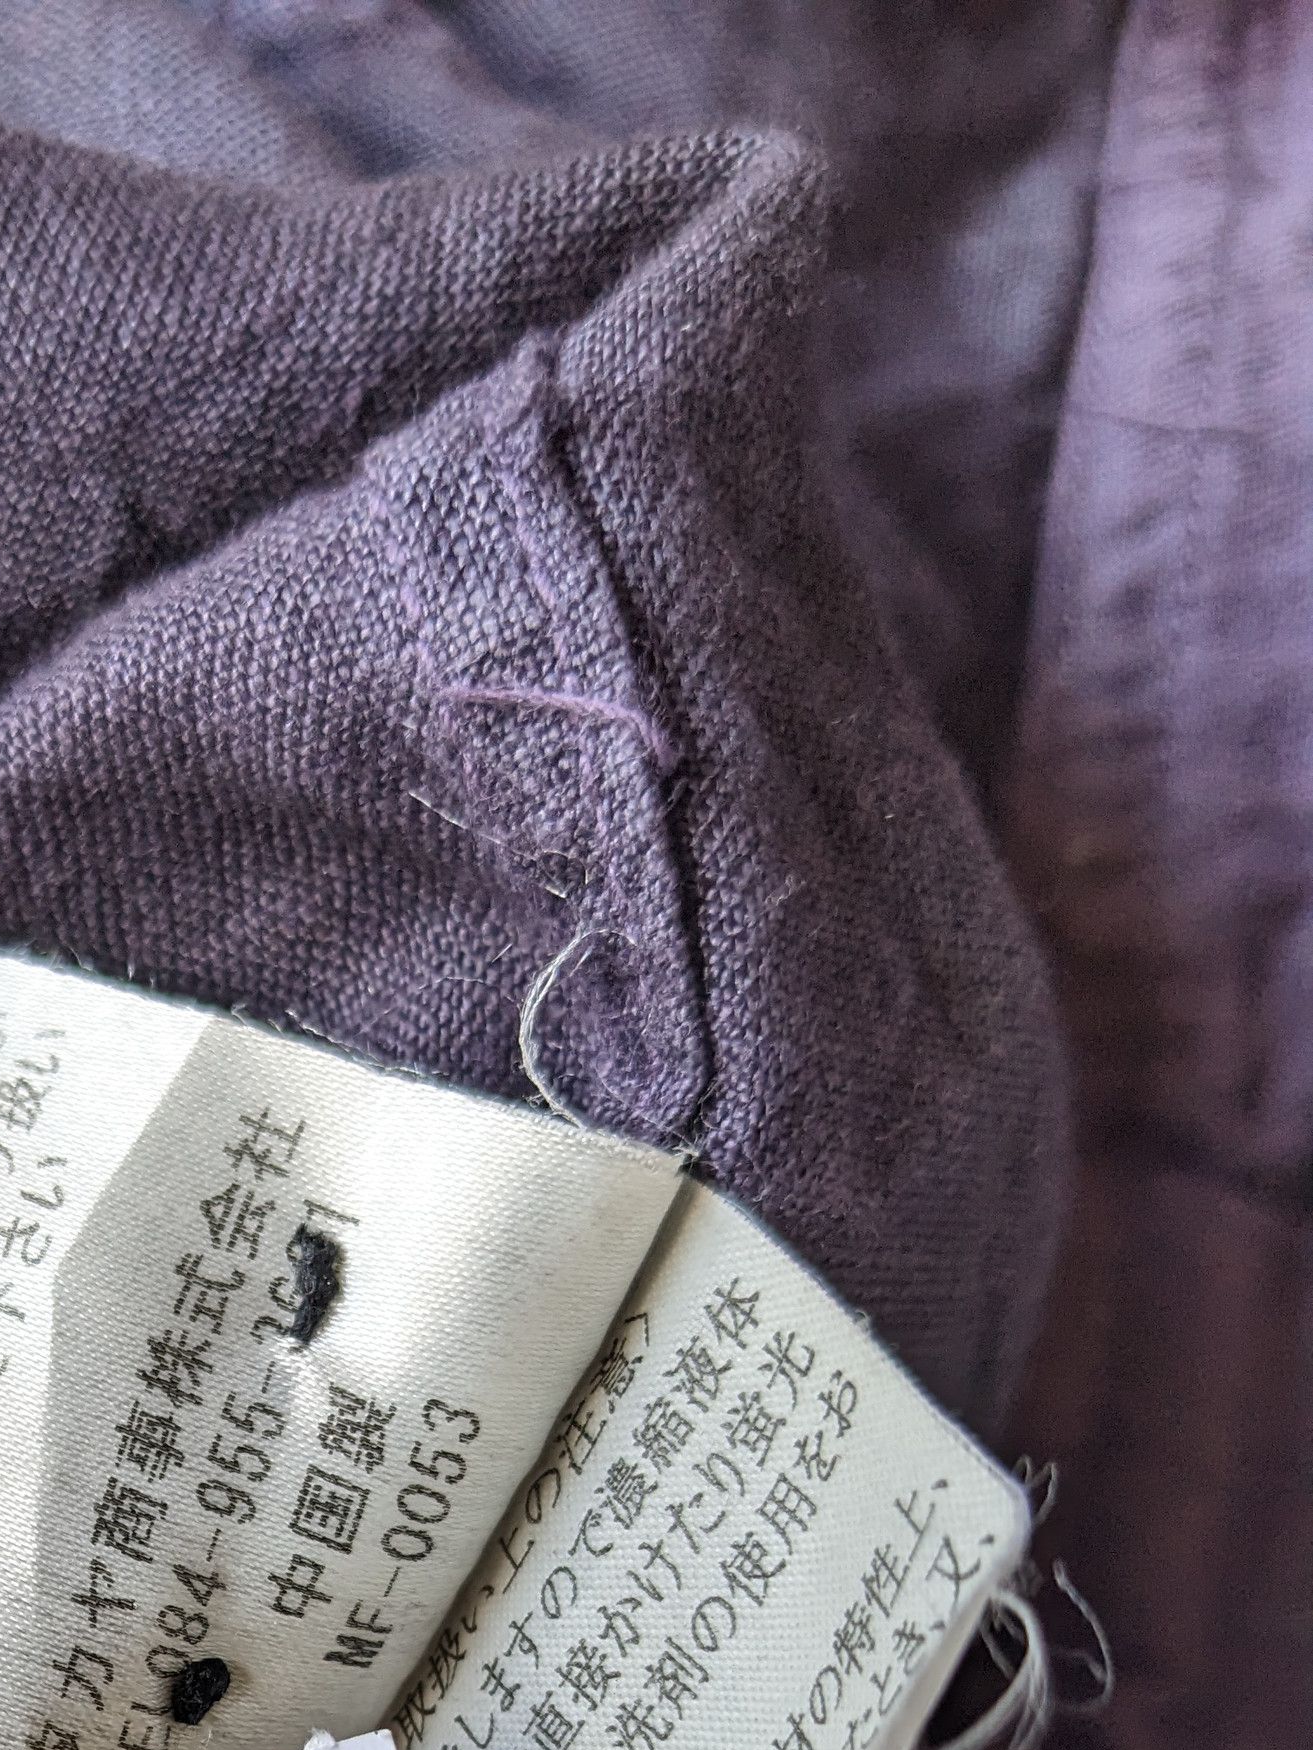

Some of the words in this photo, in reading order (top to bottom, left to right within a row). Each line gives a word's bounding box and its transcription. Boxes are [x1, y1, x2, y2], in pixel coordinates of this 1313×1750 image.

[267, 1383, 393, 1618] 中国製
[322, 1395, 480, 1666] MF-0053
